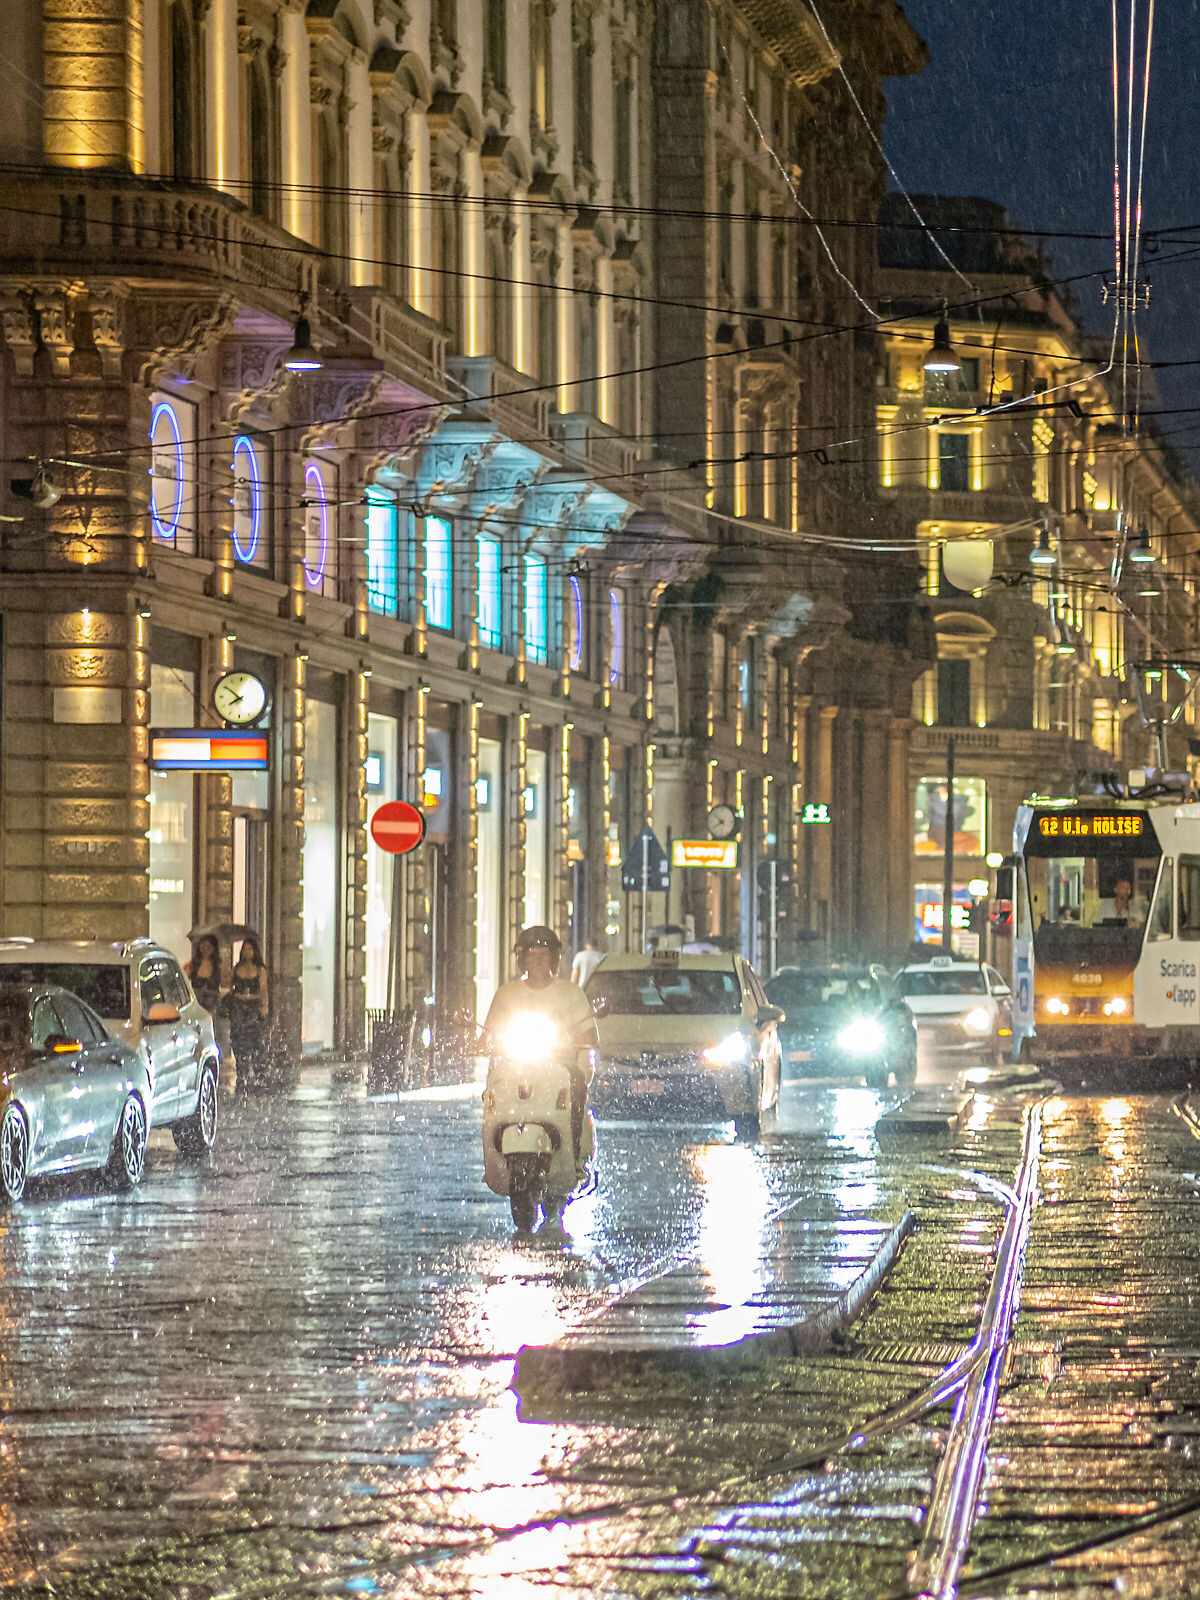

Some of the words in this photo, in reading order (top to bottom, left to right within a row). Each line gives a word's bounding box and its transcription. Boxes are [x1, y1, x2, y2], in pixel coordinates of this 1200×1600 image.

[1042, 818, 1059, 835] 12
[1093, 818, 1140, 835] MOLISE
[1160, 958, 1197, 977] Scarica
[1173, 985, 1197, 1008] l'app
